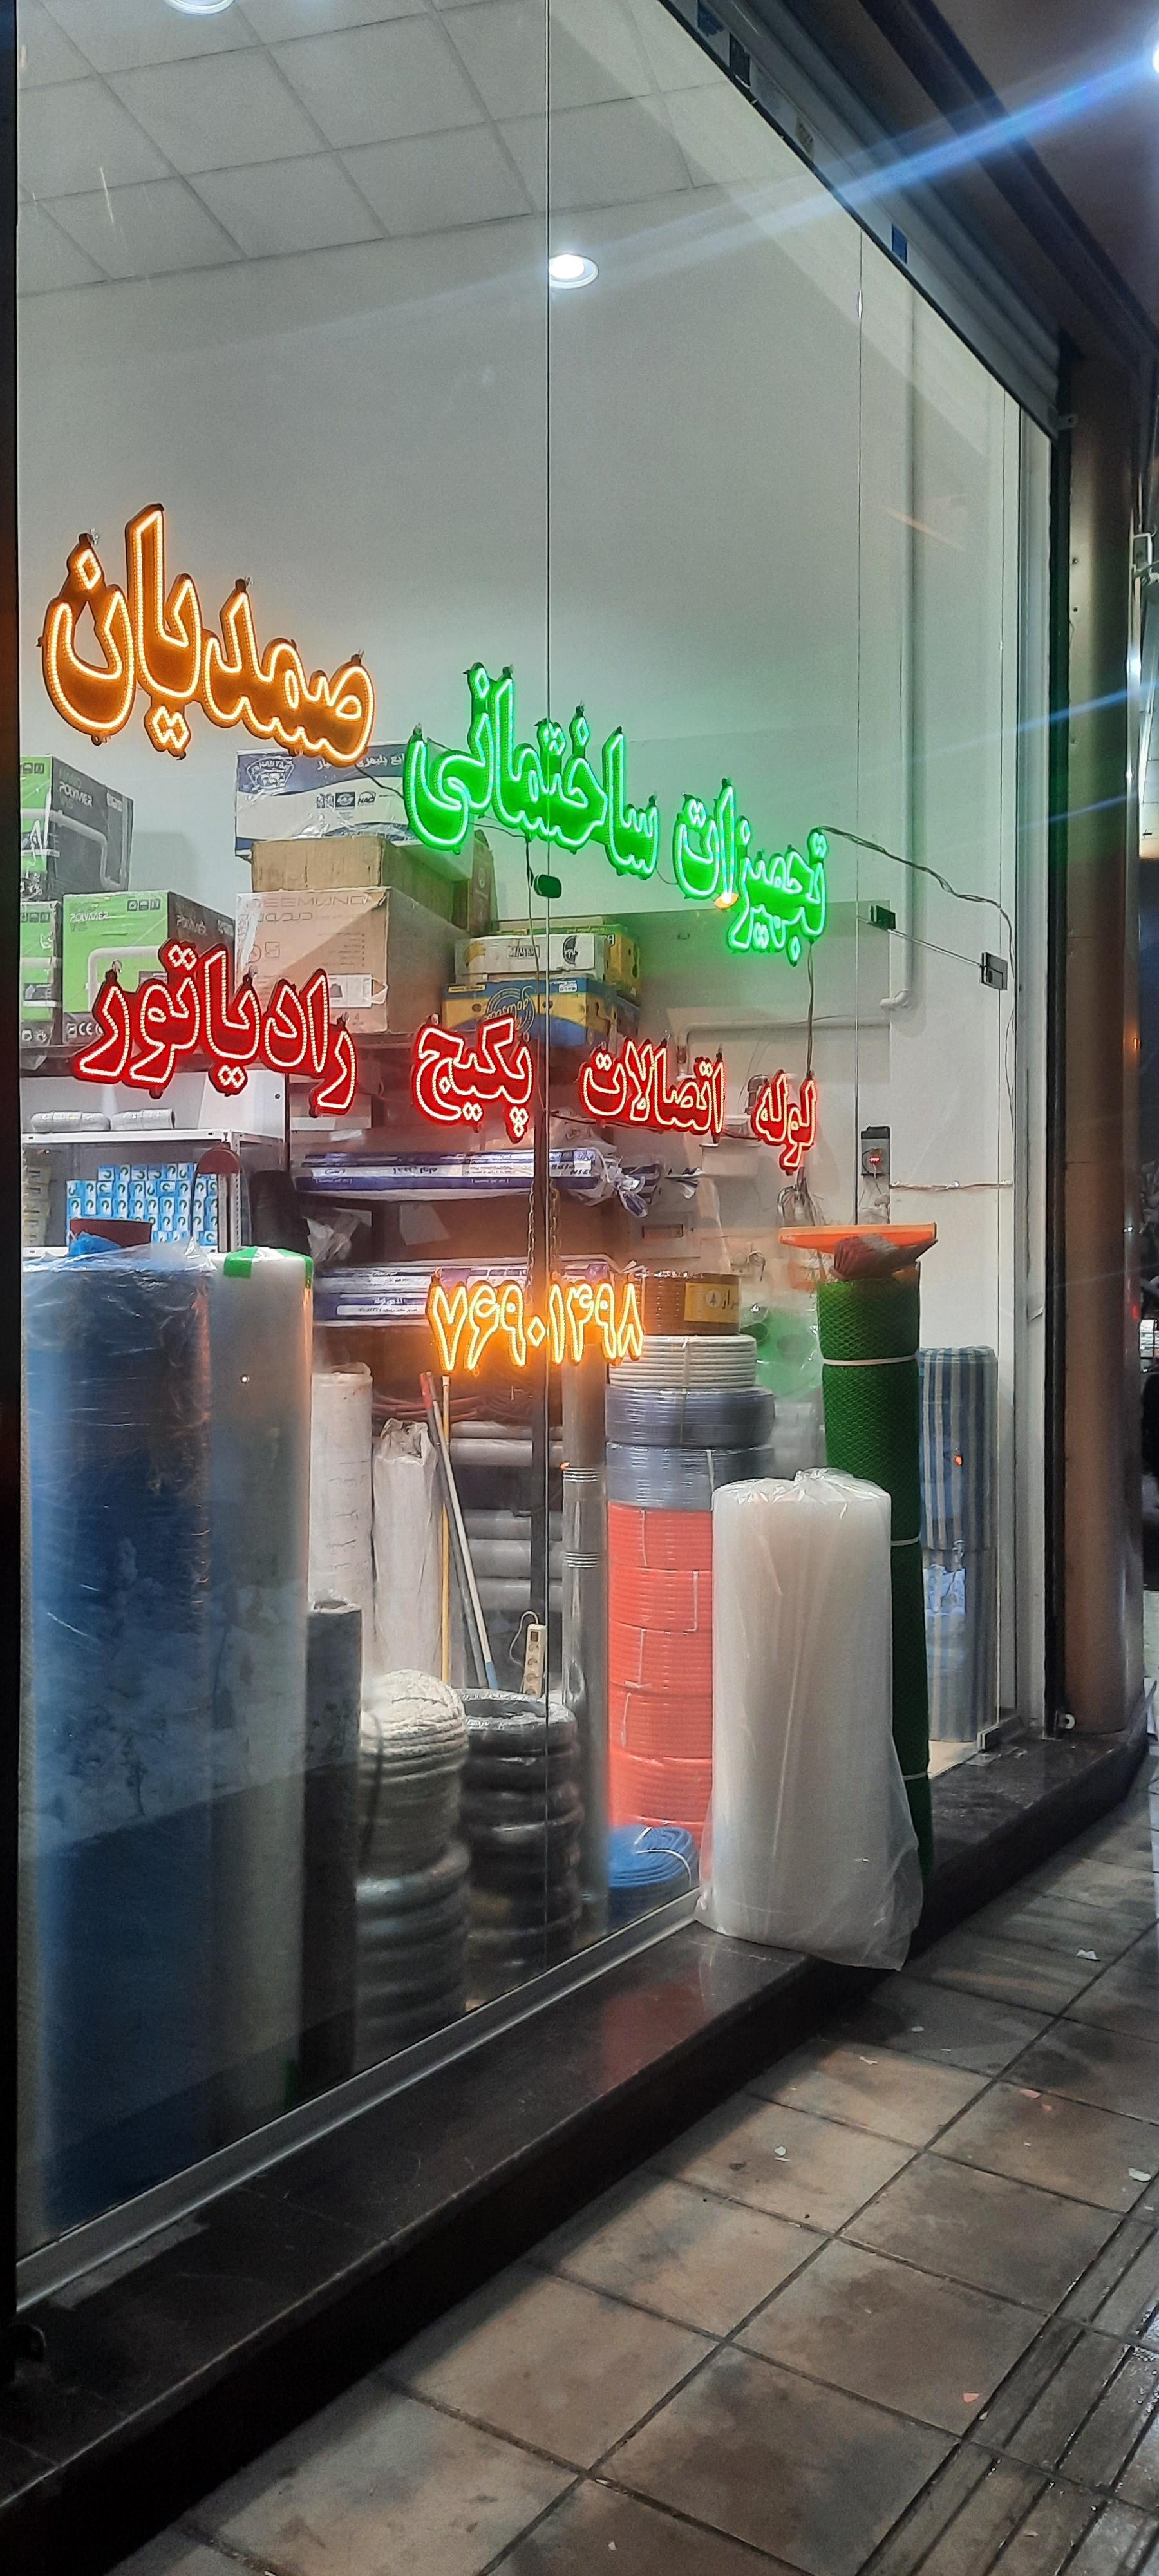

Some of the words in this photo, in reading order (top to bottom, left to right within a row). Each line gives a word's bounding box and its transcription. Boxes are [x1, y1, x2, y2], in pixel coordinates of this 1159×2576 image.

[49, 509, 375, 762] صمدیان
[408, 665, 659, 875] ساختمانی
[674, 784, 828, 964] تجهیزات
[76, 942, 355, 1112] رادیاتور
[415, 1016, 533, 1141] پکیج
[582, 1038, 726, 1133] اتصالات
[752, 1071, 818, 1170] لوله
[428, 1280, 645, 1372] ۷۶۹۰۱۴۹۸
